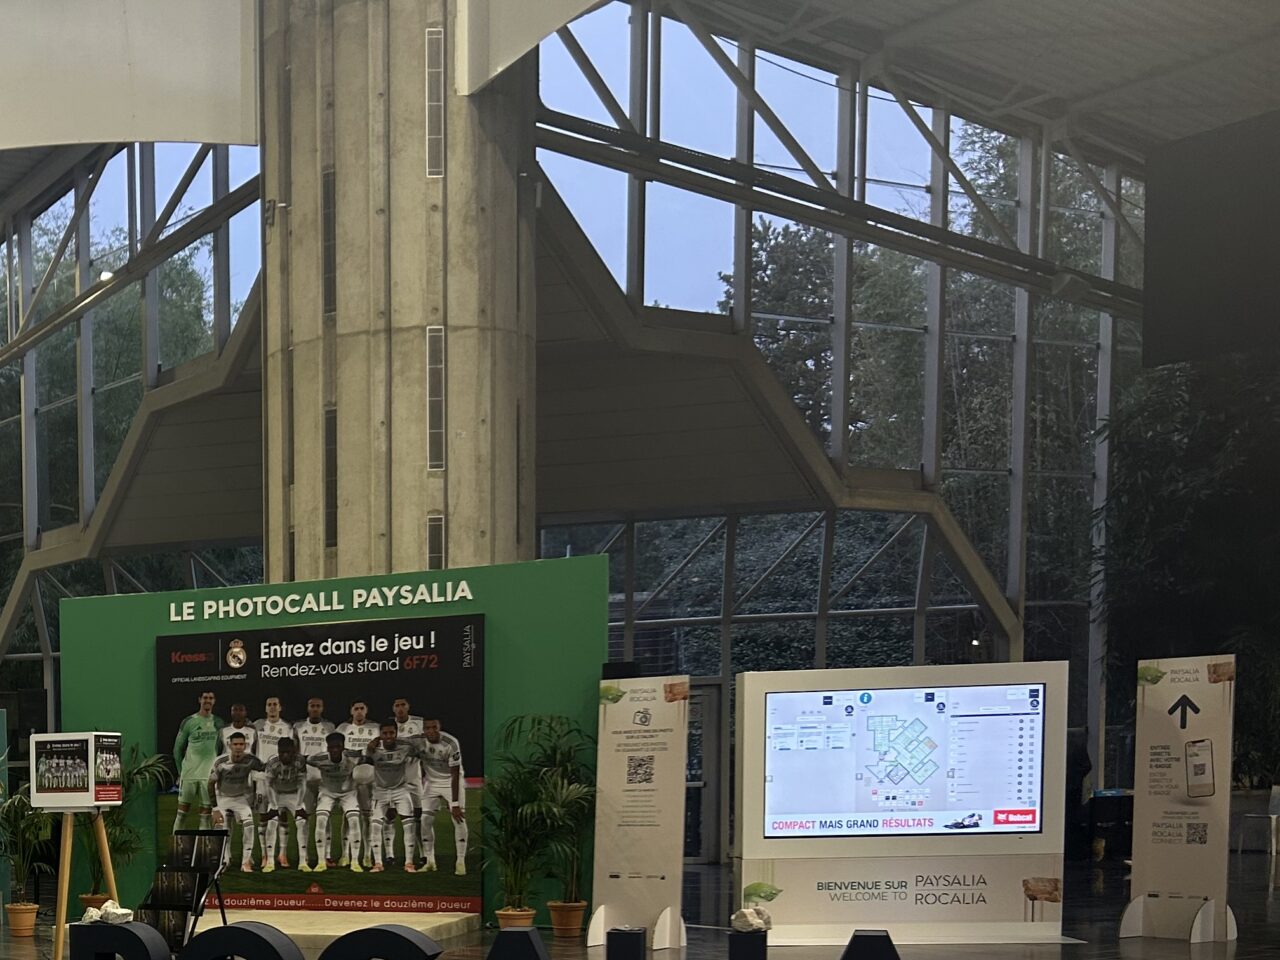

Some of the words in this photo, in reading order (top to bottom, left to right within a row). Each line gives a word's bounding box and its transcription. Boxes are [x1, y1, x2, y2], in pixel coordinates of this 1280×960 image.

[169, 601, 195, 622] LE
[203, 591, 344, 620] PHOTOCALL
[353, 580, 473, 609] PAYSALIA
[260, 642, 314, 659] Entrez
[319, 638, 365, 656] dans
[371, 635, 388, 652] le
[394, 633, 424, 655] jeu
[429, 631, 436, 649] !
[462, 624, 472, 668] PAYSALIA
[171, 651, 206, 664] Kress
[261, 660, 354, 678] Rendez-vous
[357, 656, 400, 673] stand
[403, 654, 438, 670] 6F72
[772, 820, 816, 830] COMPACT
[819, 820, 843, 829] MAIS
[846, 819, 879, 829] GRAND
[882, 817, 934, 828] RÉSULTATS
[817, 881, 881, 891] BIENVENUE
[884, 880, 908, 891] SUR
[915, 874, 988, 888] PAYSALIA
[829, 891, 889, 902] WELCOME
[891, 891, 908, 901] TO
[914, 892, 988, 905] ROCALIA
[224, 897, 271, 906] douzième
[324, 898, 368, 908] Devenez
[371, 899, 380, 908] le
[383, 899, 434, 909] douzième
[437, 900, 472, 911] joueur
